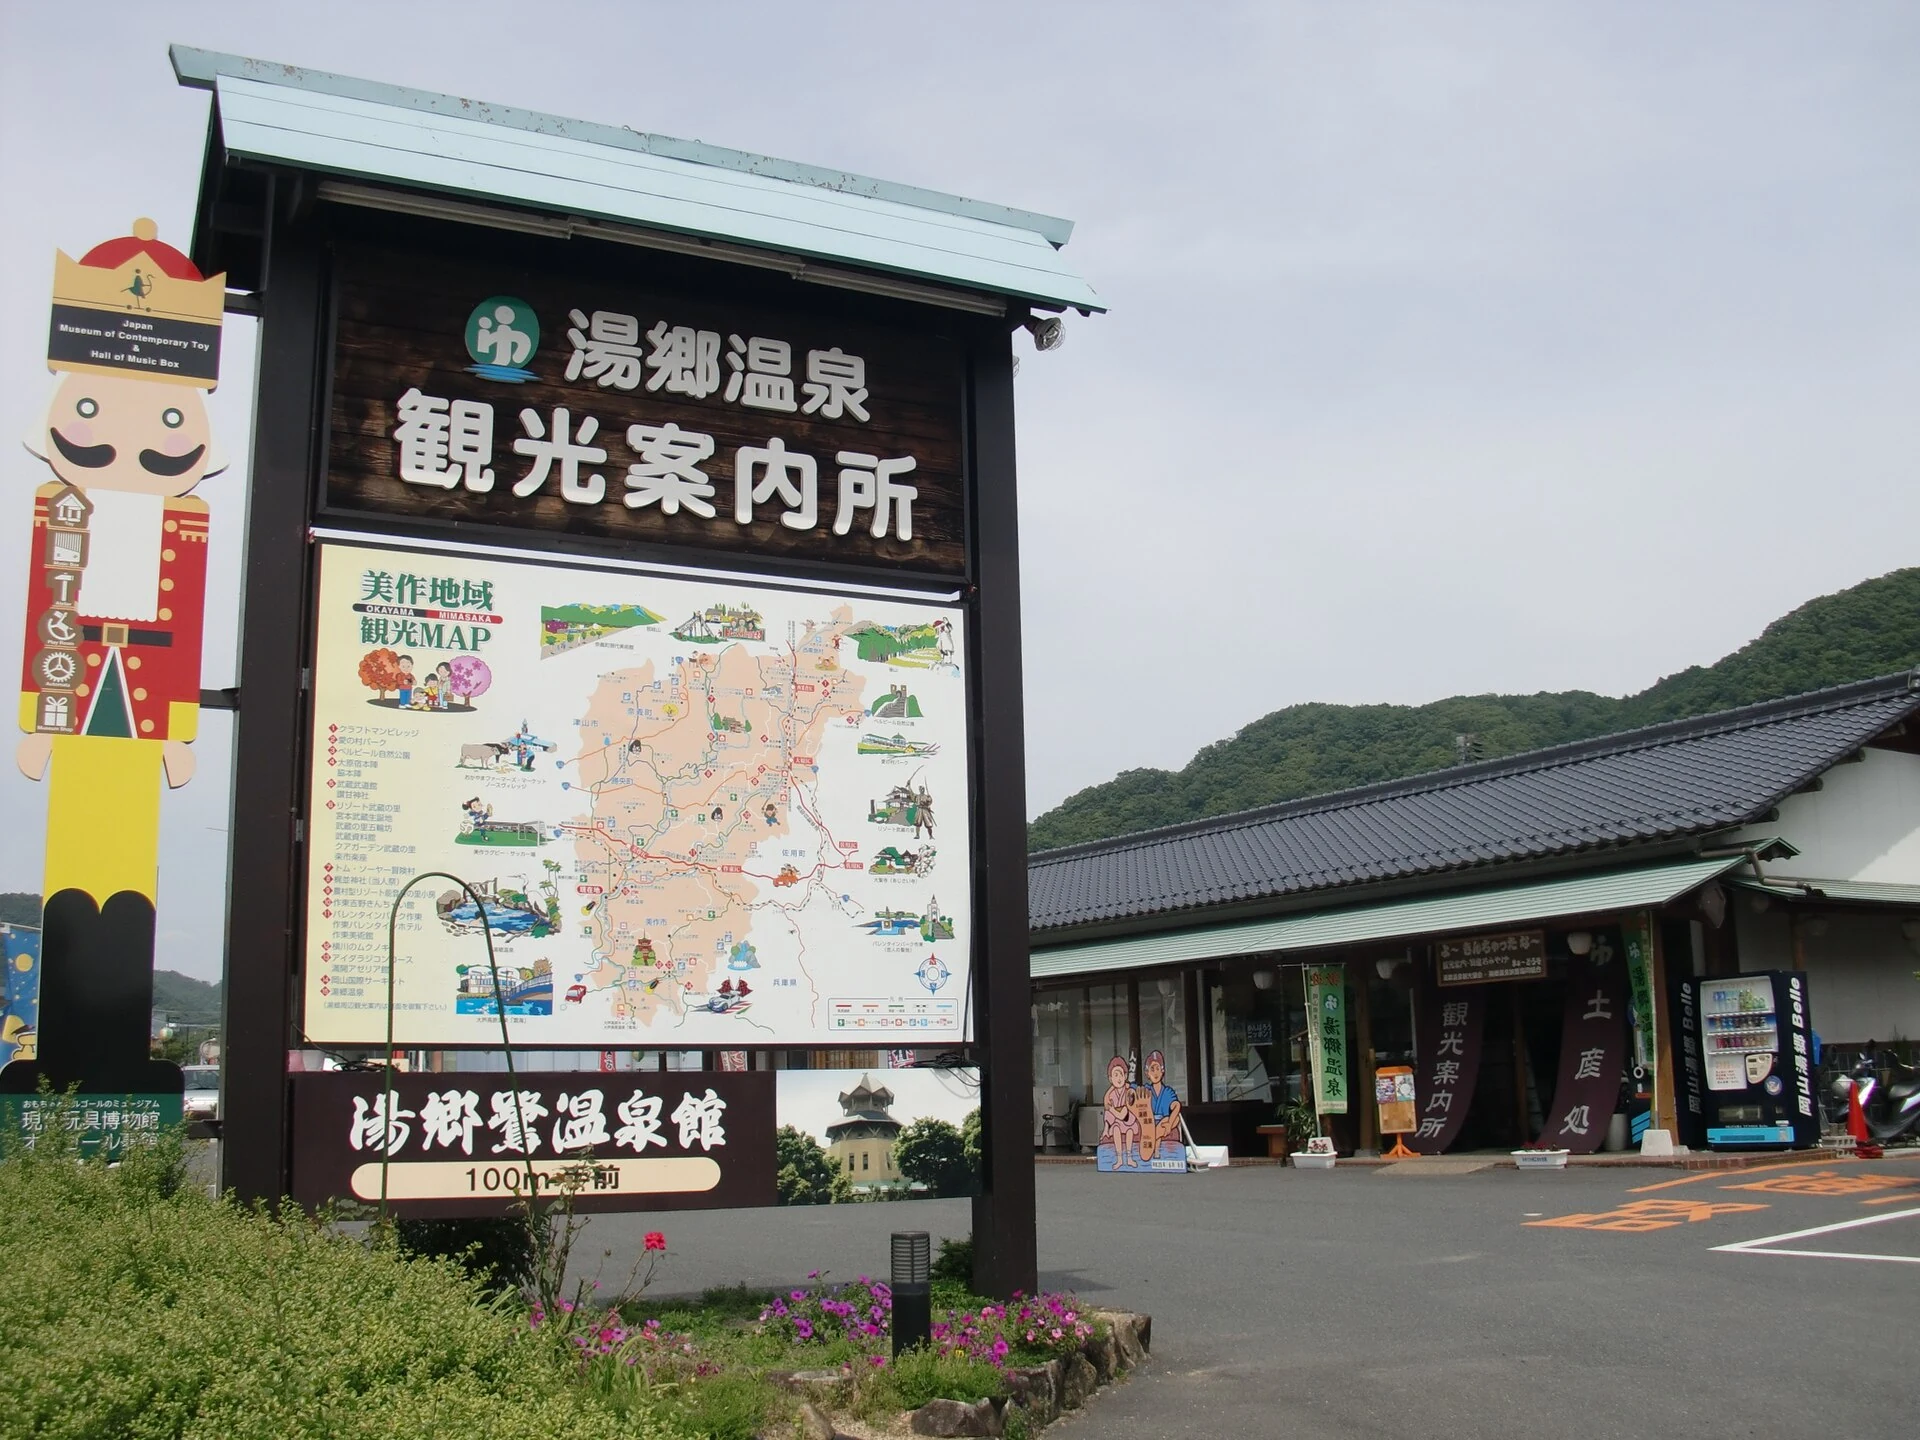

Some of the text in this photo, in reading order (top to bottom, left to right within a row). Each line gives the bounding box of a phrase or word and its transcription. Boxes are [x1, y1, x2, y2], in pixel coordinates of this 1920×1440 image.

[123, 320, 153, 331] Japan
[60, 324, 210, 352] Museum of Contemporary Toy
[132, 344, 140, 353] &
[91, 350, 180, 369] Hall of Music Box
[565, 309, 870, 423] 湯郷温泉
[393, 388, 918, 542] 観光案内所
[361, 570, 494, 611] 美作地域
[366, 605, 492, 623] OKAYAMA MIMASAKA
[361, 616, 491, 652] 観光MAP
[573, 719, 598, 727] 津山市
[338, 725, 419, 738] クラフトマンビレッジ
[338, 736, 386, 747] 愛の村パーク
[338, 759, 378, 769] 大原宿本陣
[337, 801, 401, 813] リゾート武蔵の里
[335, 842, 416, 854] クアガーデン武蔵の里
[782, 849, 806, 857] 佐用町
[335, 864, 415, 875] トム・ソーヤー冒険村
[579, 886, 601, 894] 現在地
[646, 918, 667, 926] 美作市
[332, 932, 373, 940] 作東美術館
[331, 975, 404, 985] 岡山国際サーキト
[773, 979, 797, 987] 兵庫県
[331, 988, 364, 997] 湯郷温泉
[1681, 982, 1694, 1032] Belle
[1789, 977, 1804, 1030] Belle
[1559, 989, 1613, 1136] 土産処
[1415, 1002, 1469, 1138] 観光案内所
